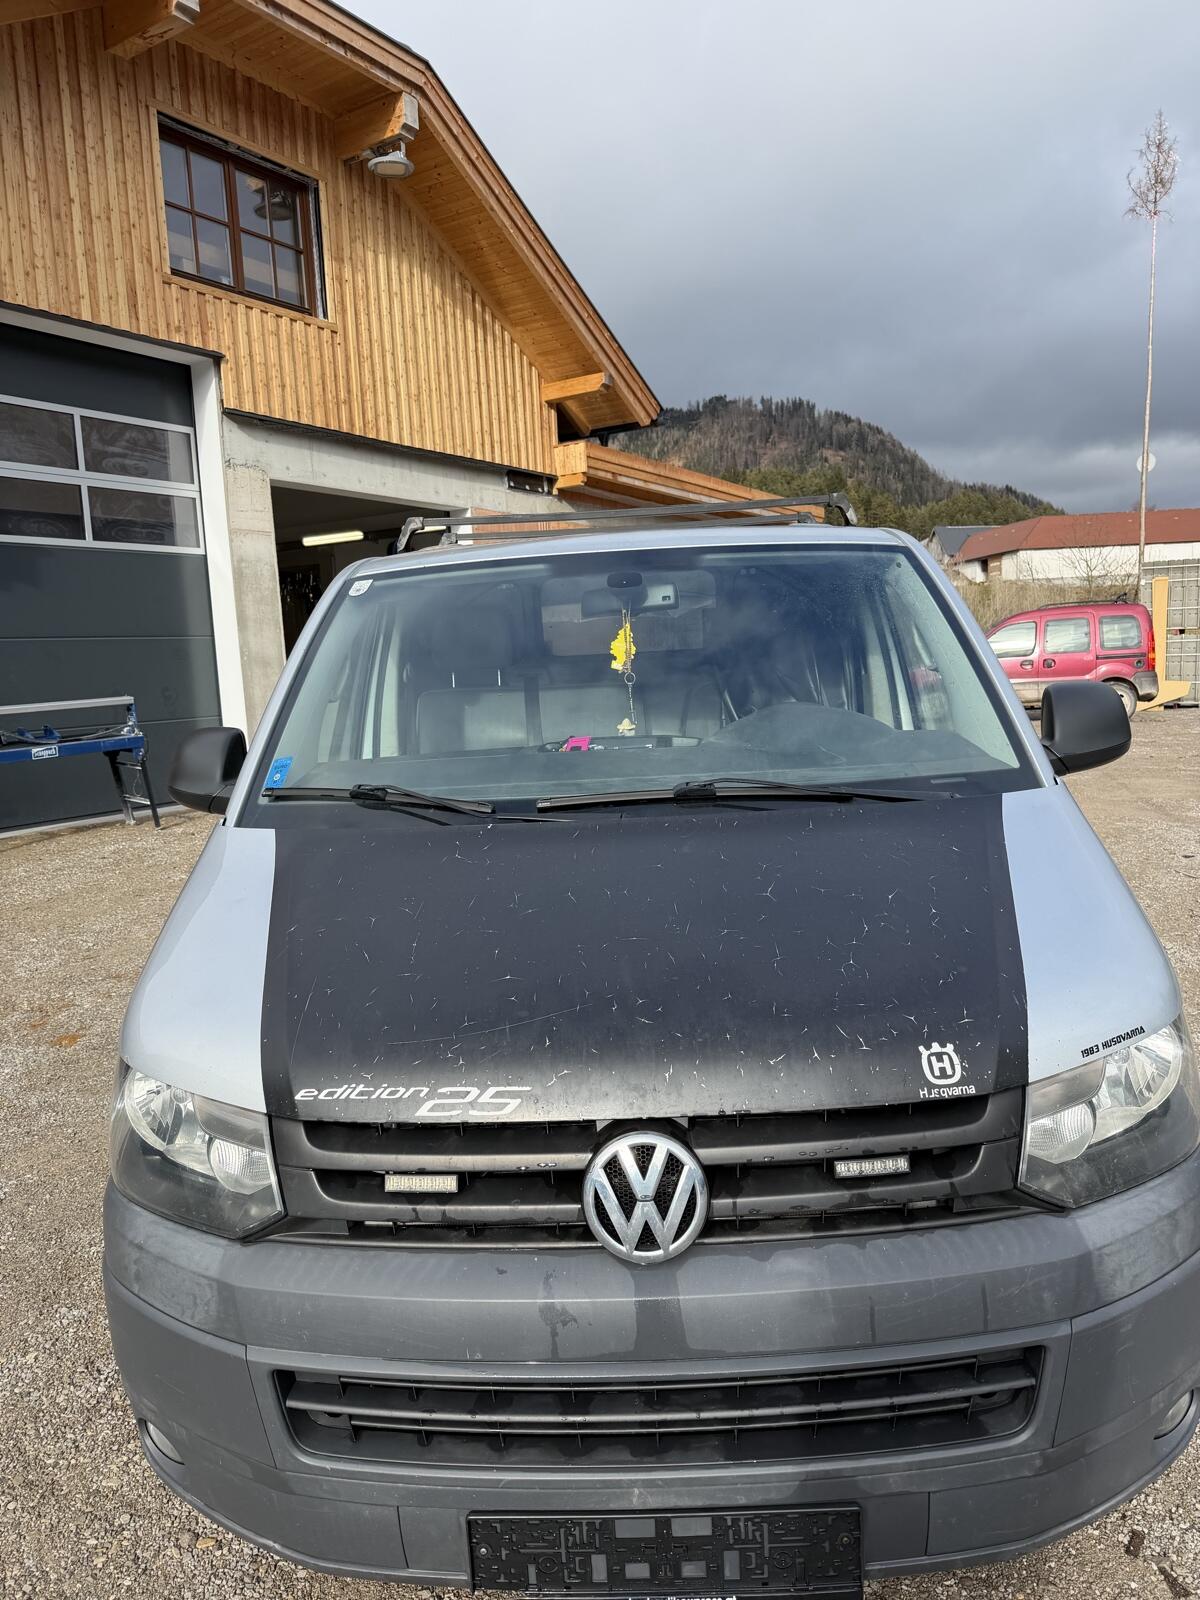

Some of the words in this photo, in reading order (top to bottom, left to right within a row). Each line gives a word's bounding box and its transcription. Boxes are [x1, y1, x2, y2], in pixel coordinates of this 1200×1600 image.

[1080, 1043, 1100, 1058] 1983
[294, 1083, 430, 1101] edition
[414, 1086, 532, 1116] 25
[593, 1141, 699, 1257] VW
